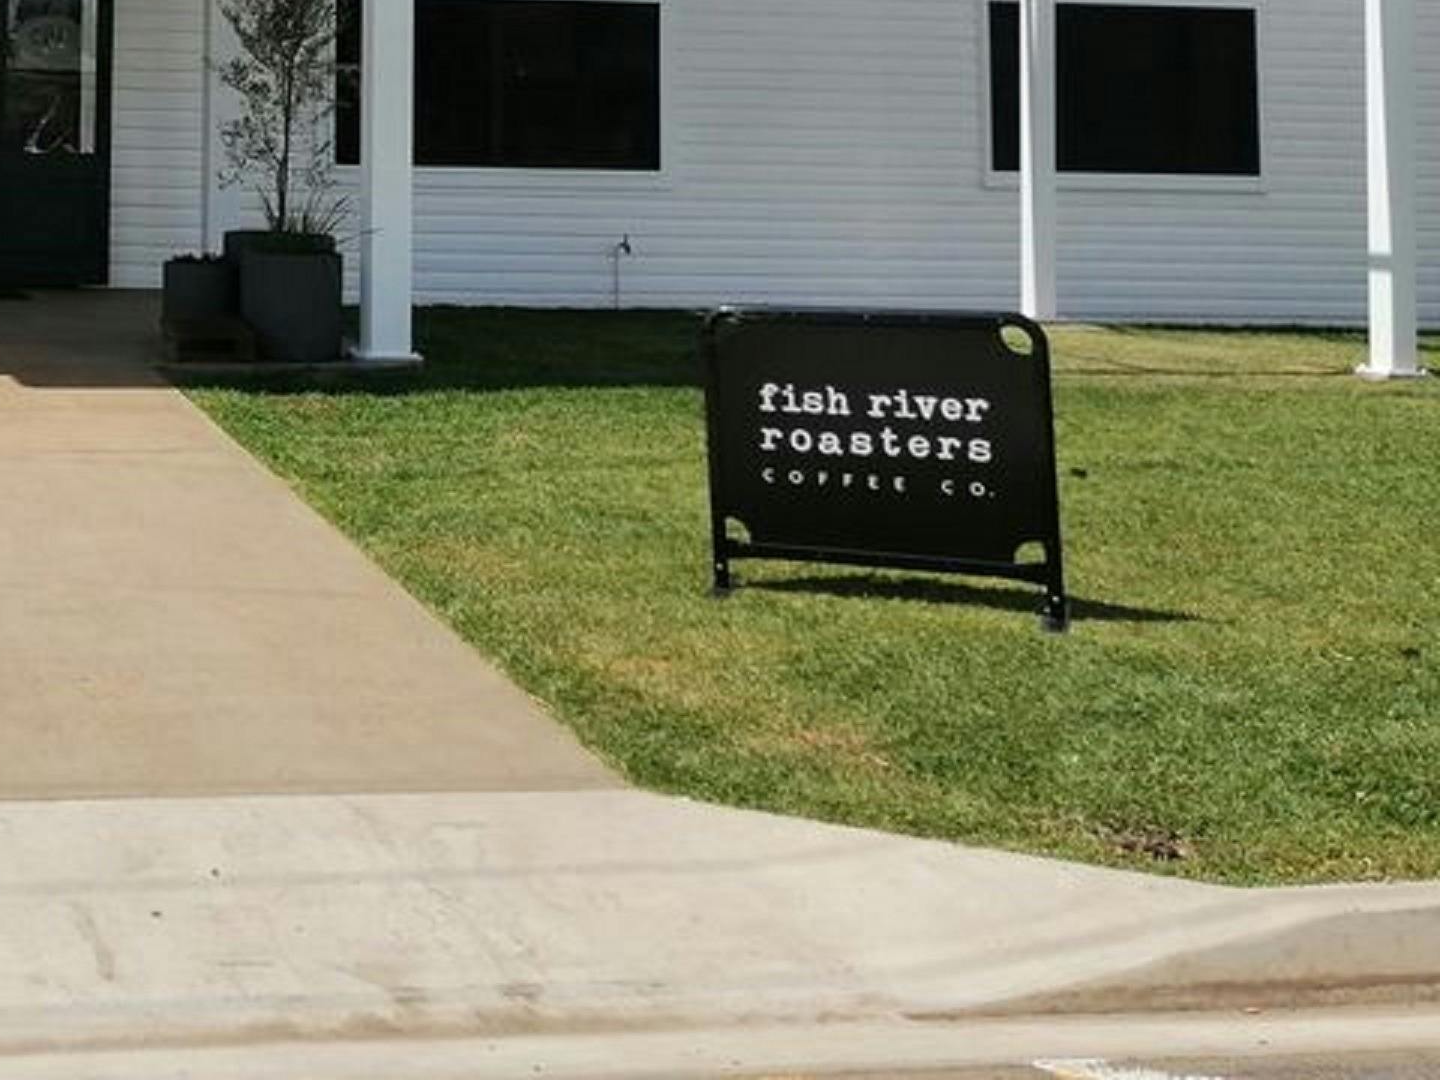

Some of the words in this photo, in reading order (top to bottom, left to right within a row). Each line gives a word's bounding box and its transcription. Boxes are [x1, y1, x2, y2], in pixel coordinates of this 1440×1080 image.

[759, 383, 851, 416] fish
[866, 389, 990, 422] river
[760, 426, 992, 463] roasters
[761, 467, 906, 493] COFFEE
[940, 478, 996, 497] CO.
